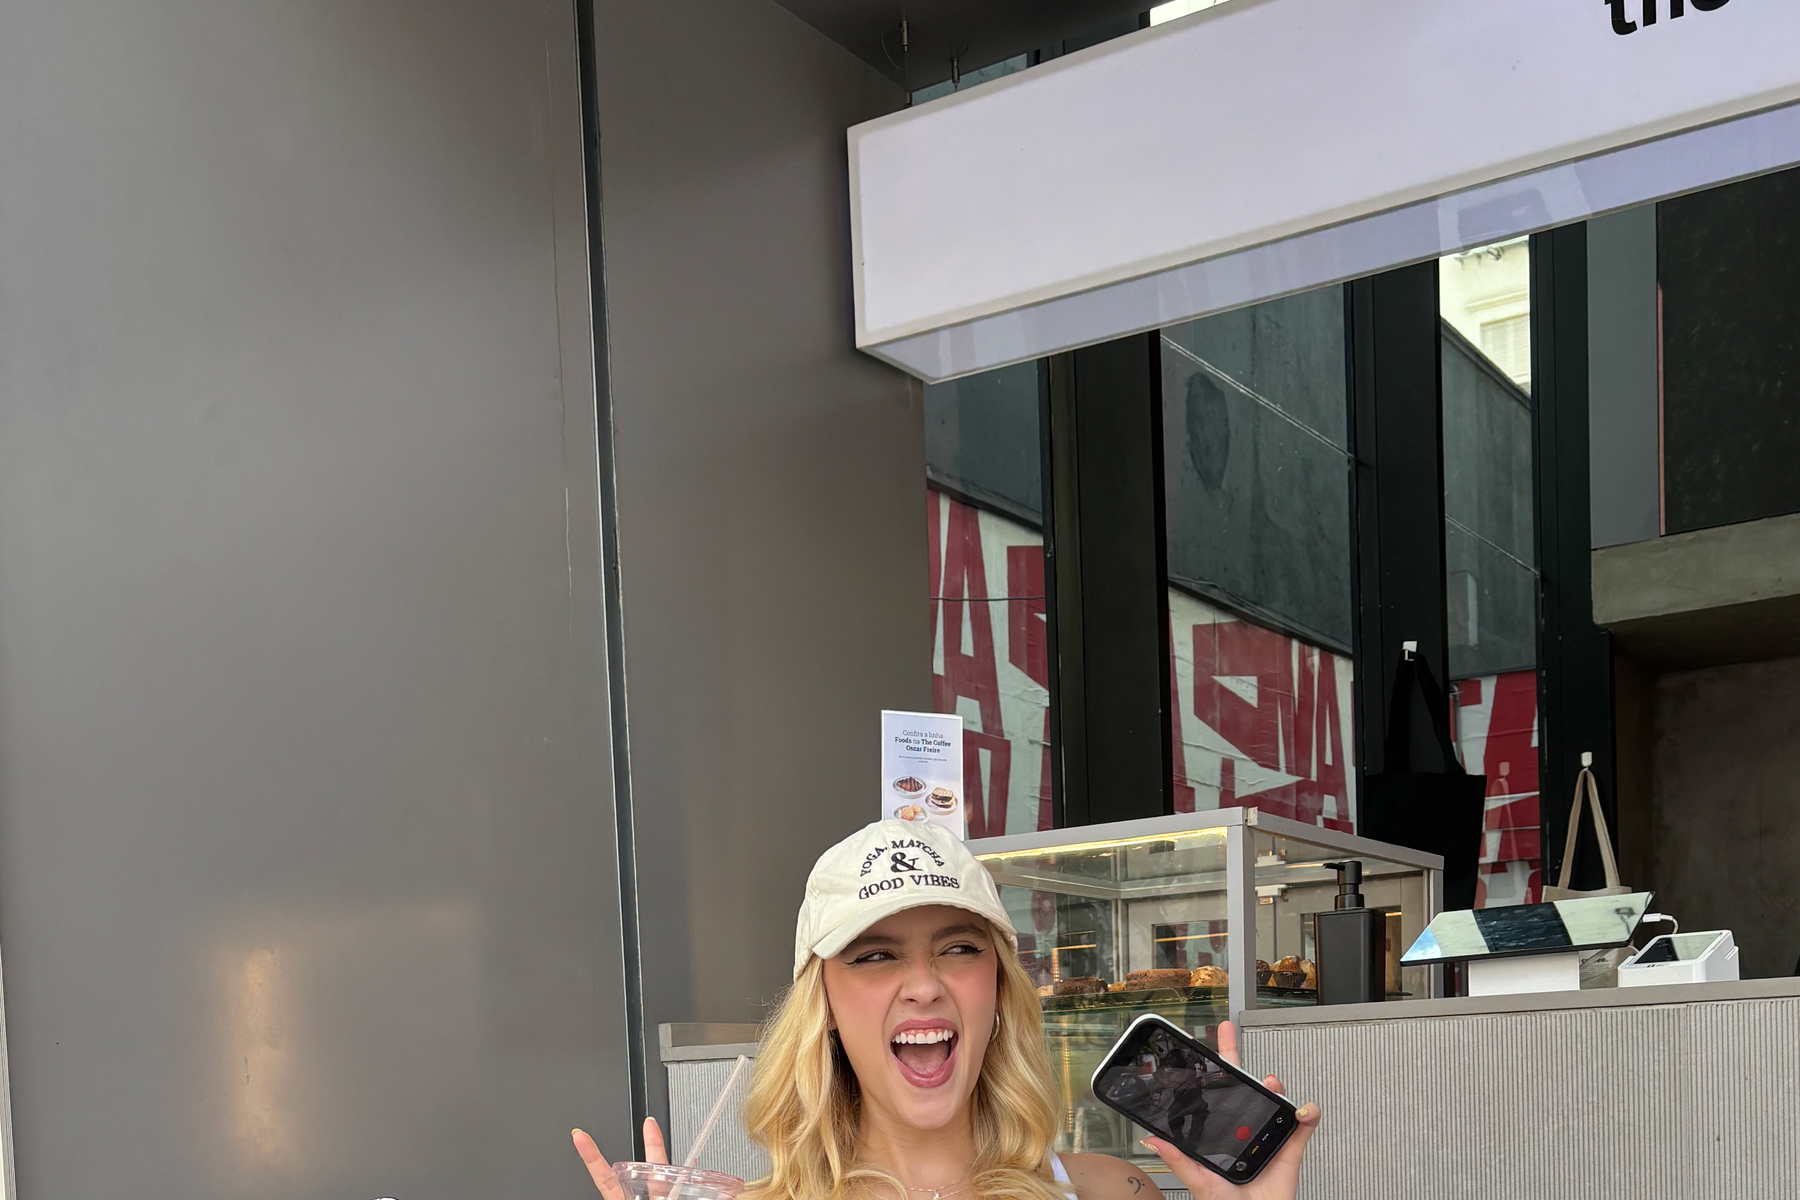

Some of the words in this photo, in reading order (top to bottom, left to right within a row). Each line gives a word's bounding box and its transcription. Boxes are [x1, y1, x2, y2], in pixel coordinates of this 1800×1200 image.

[894, 736, 912, 744] Foods
[921, 738, 932, 746] The
[932, 739, 951, 747] Coffee
[905, 744, 923, 752] Oscar
[890, 851, 923, 873] &
[891, 839, 945, 867] MATCHA
[858, 877, 905, 900] GOOD
[909, 874, 960, 889] VIBES
